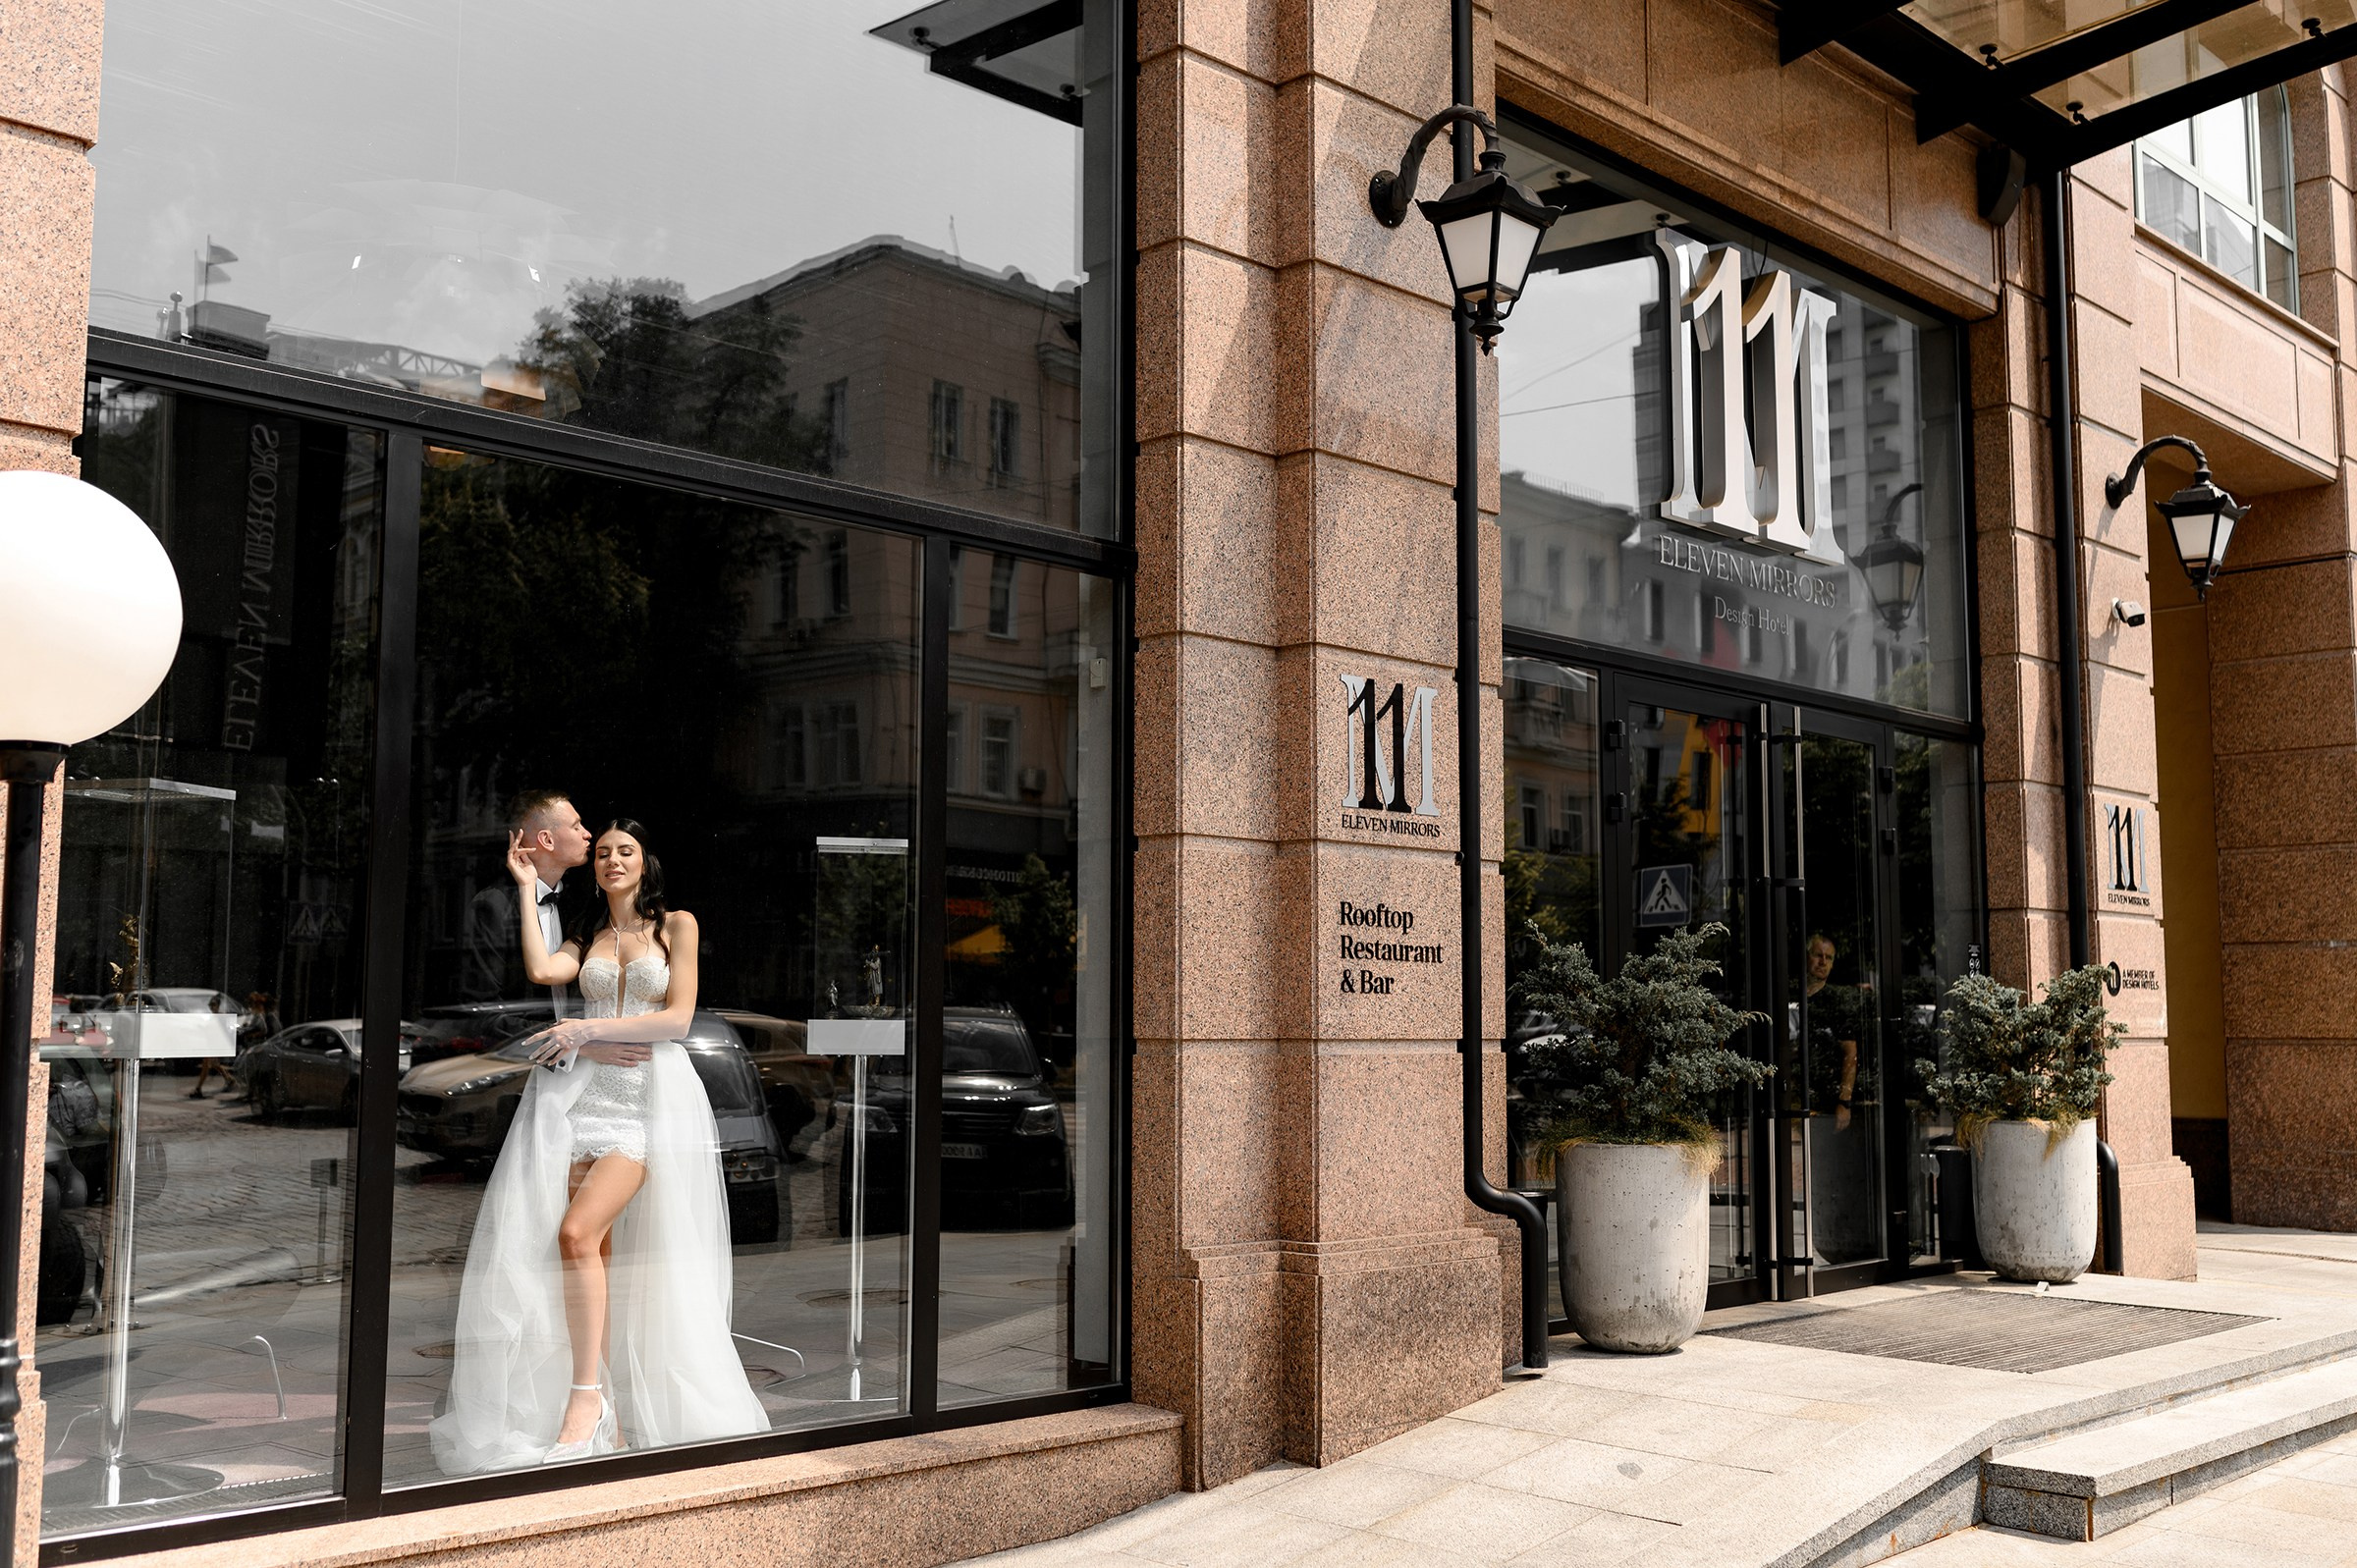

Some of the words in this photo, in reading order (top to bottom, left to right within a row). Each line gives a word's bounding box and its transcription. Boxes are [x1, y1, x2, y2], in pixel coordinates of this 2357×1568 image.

[1658, 534, 1744, 582] ELEVEN
[1749, 562, 1836, 609] MIRRORS
[1714, 596, 1754, 629] Design
[1758, 610, 1790, 636] Hotel
[1341, 814, 1387, 833] ELEVEN
[1390, 820, 1440, 838] MIRRORS
[2108, 892, 2127, 904] ELEVEN
[2128, 895, 2150, 906] MIRRORS
[1340, 901, 1414, 934] Rooftop
[1340, 935, 1444, 964] Restaurant
[1340, 969, 1356, 995] &
[1359, 970, 1395, 996] Bar
[2122, 969, 2127, 978] A
[2127, 969, 2149, 980] MEMBER
[2149, 970, 2156, 980] OF
[2122, 980, 2141, 990] DESIGN
[2141, 980, 2160, 991] HOTELS
